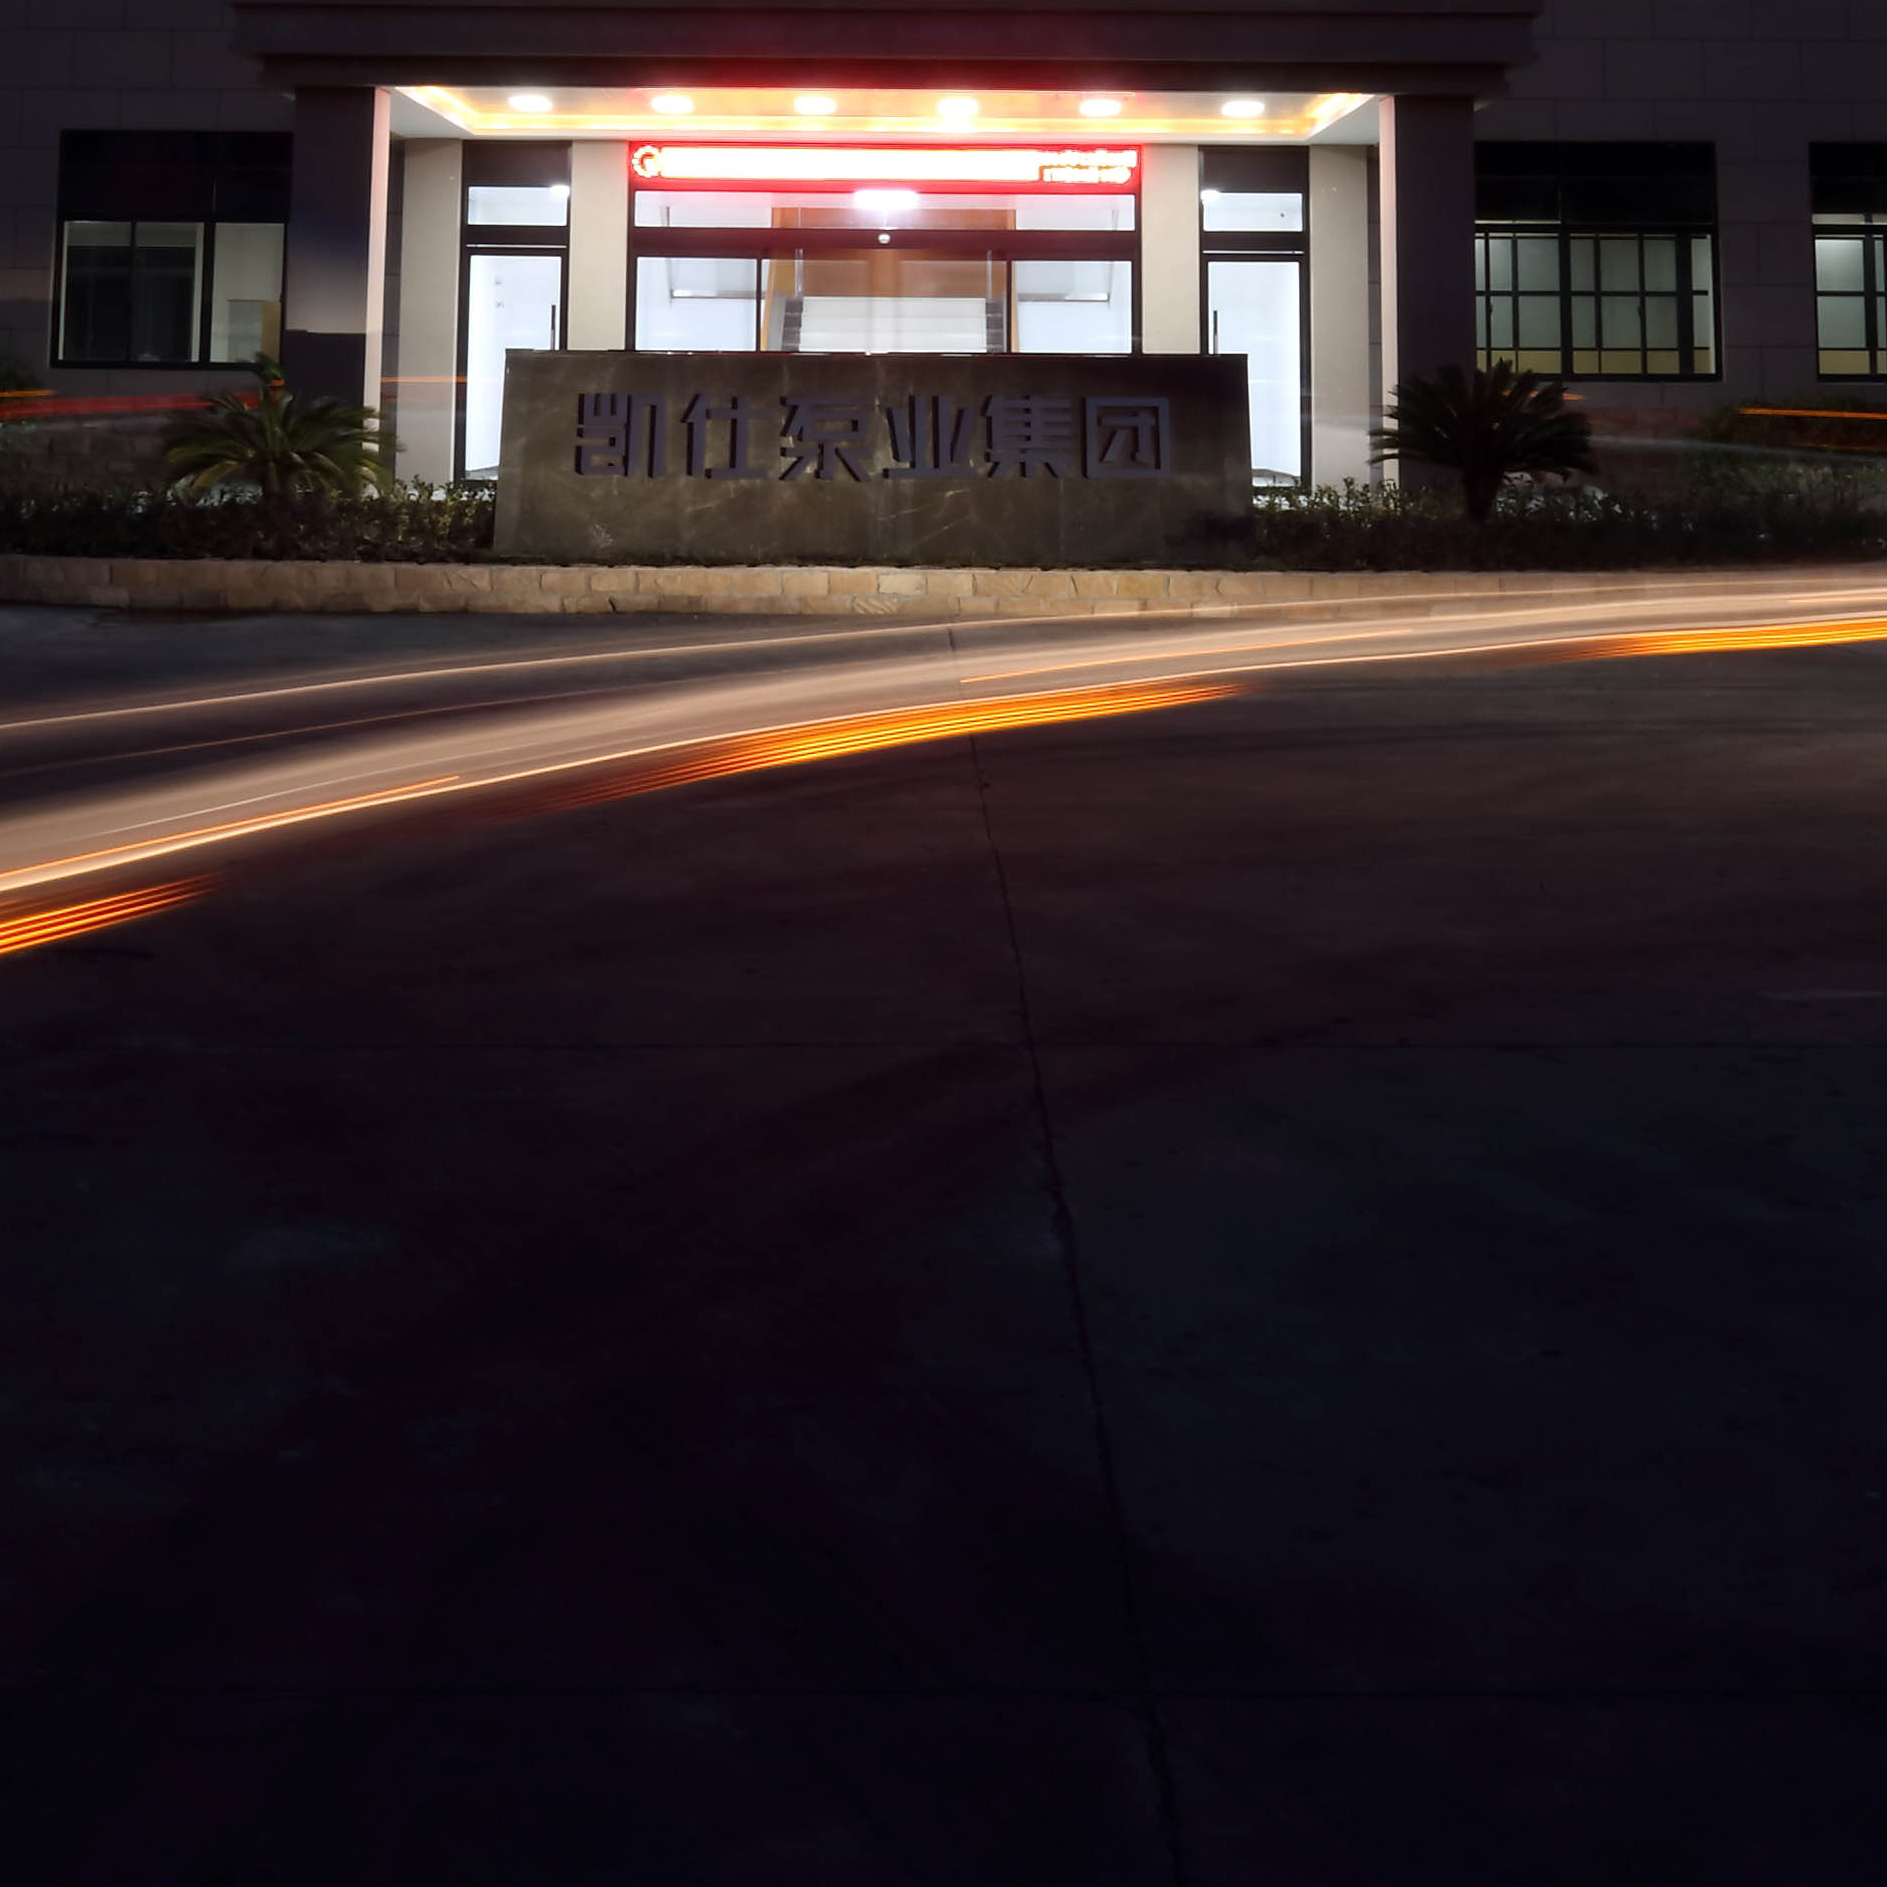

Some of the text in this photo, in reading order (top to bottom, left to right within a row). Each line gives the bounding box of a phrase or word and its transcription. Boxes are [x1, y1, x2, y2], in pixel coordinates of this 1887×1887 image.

[575, 393, 1172, 481] 凯仕泵业集团
